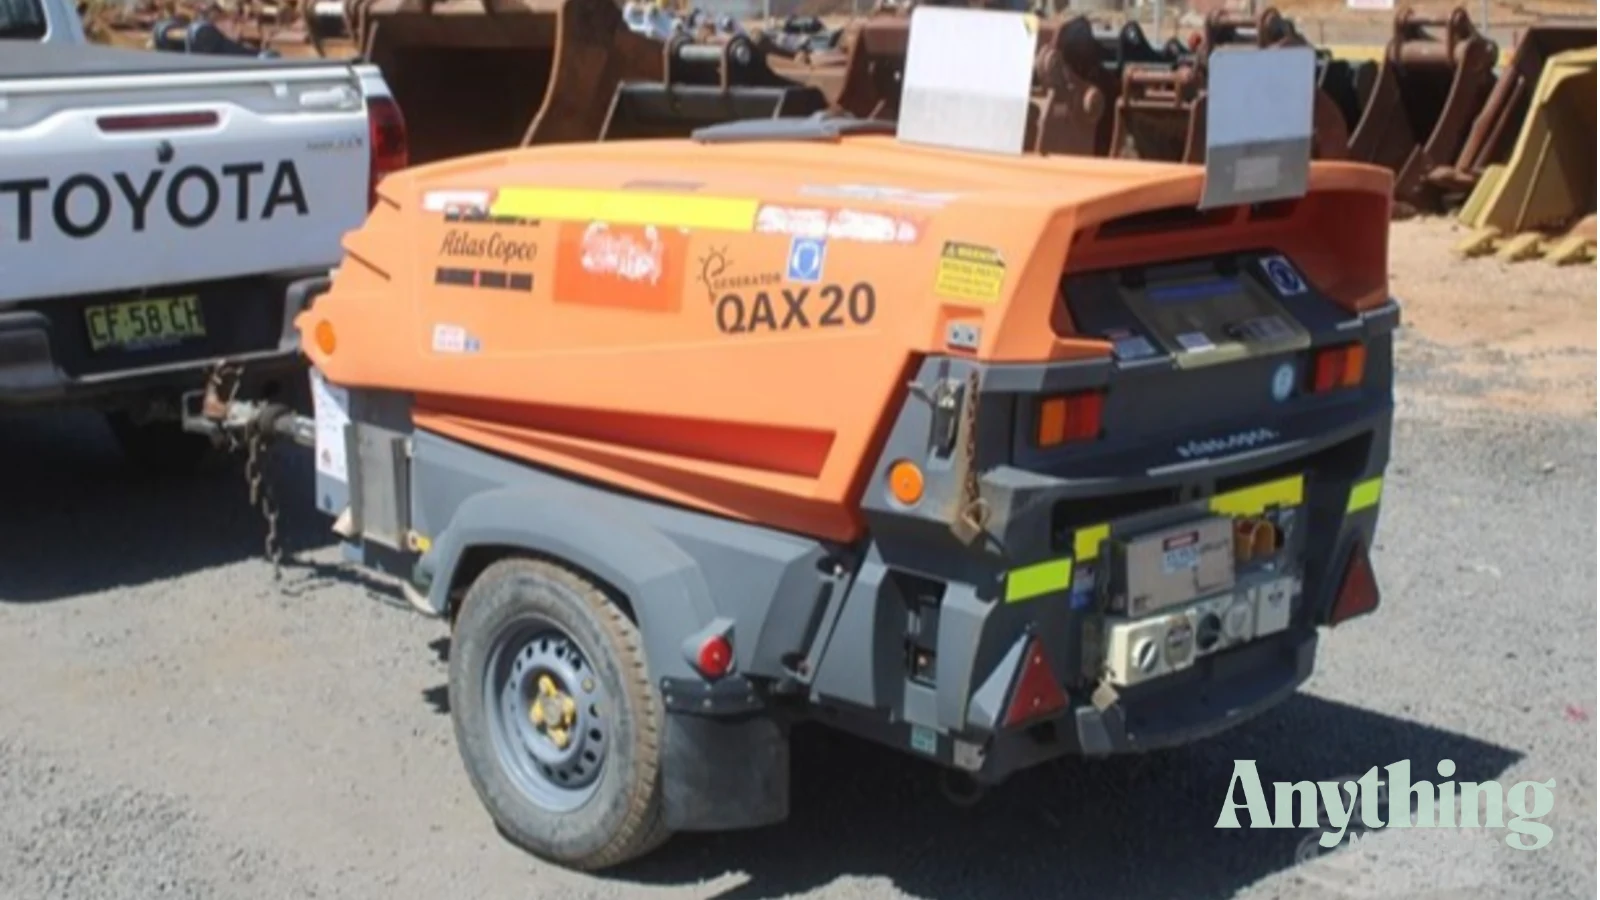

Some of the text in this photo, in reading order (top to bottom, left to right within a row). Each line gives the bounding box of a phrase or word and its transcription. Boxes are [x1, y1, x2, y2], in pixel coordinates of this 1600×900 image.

[0, 160, 309, 241] TOYOTA
[715, 281, 876, 334] QAX 20
